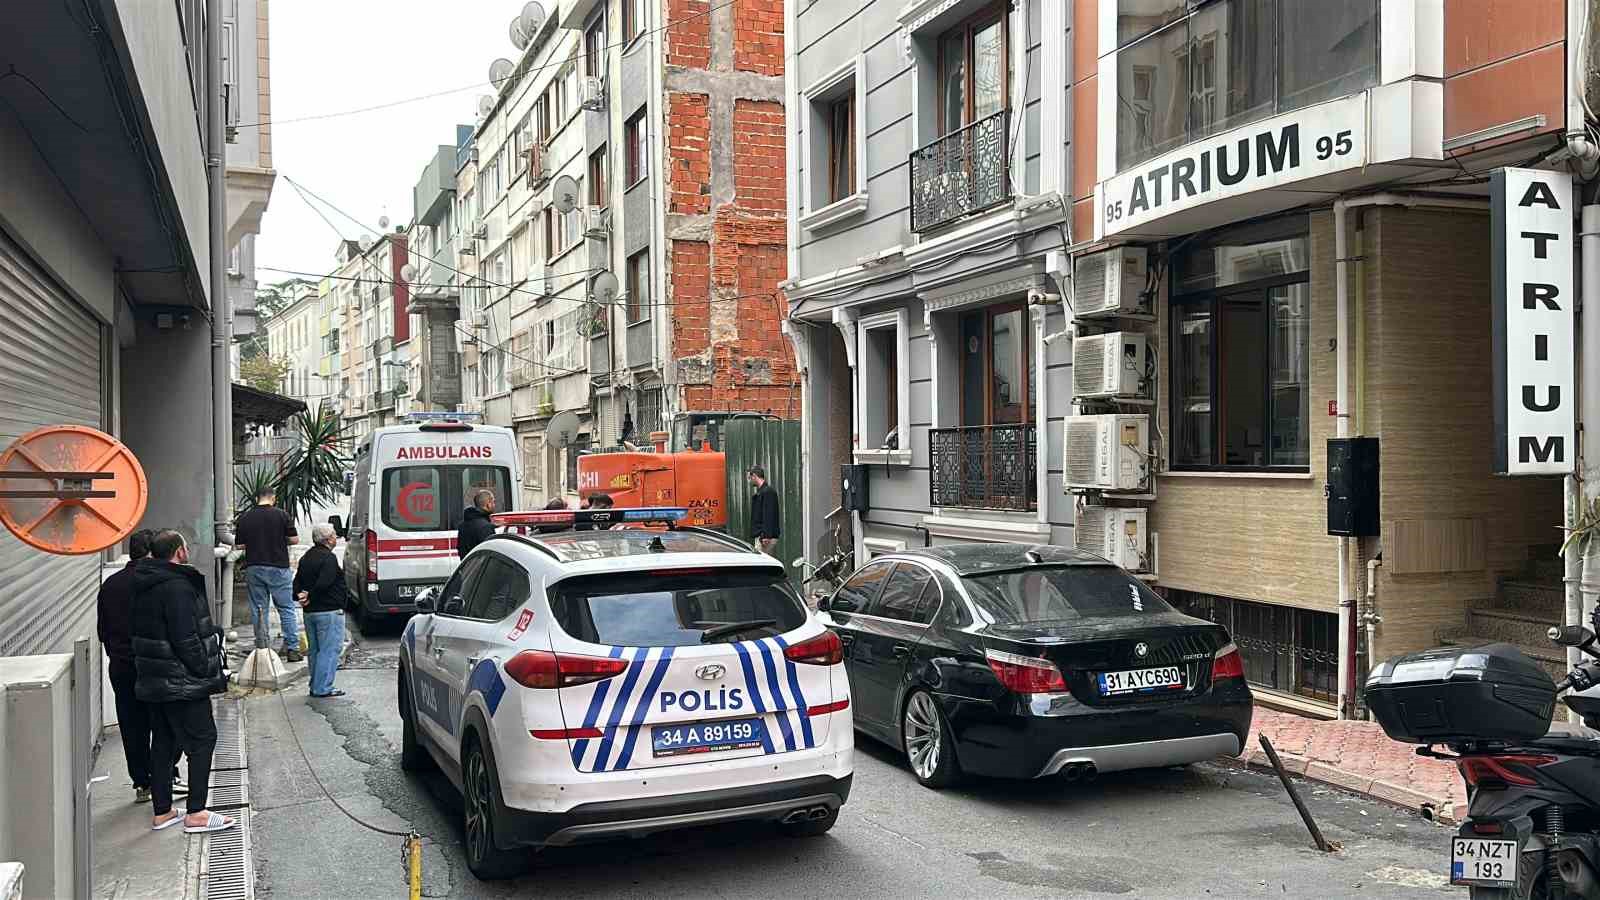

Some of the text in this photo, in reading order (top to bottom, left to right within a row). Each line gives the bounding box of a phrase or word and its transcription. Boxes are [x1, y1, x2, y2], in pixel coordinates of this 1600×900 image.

[1106, 122, 1353, 223] 95 ATRIUM 95
[1518, 181, 1565, 463] ATRIUM
[396, 446, 492, 460] AMBULANS
[1101, 423, 1110, 478] REGAL
[577, 471, 599, 488] CHI
[411, 493, 434, 513] 112
[1106, 667, 1179, 689] 31 AYC690
[660, 684, 744, 713] POLİS
[661, 723, 752, 746] 34 A 89159
[1456, 841, 1515, 859] 34 NZT
[1474, 862, 1503, 878] 193
